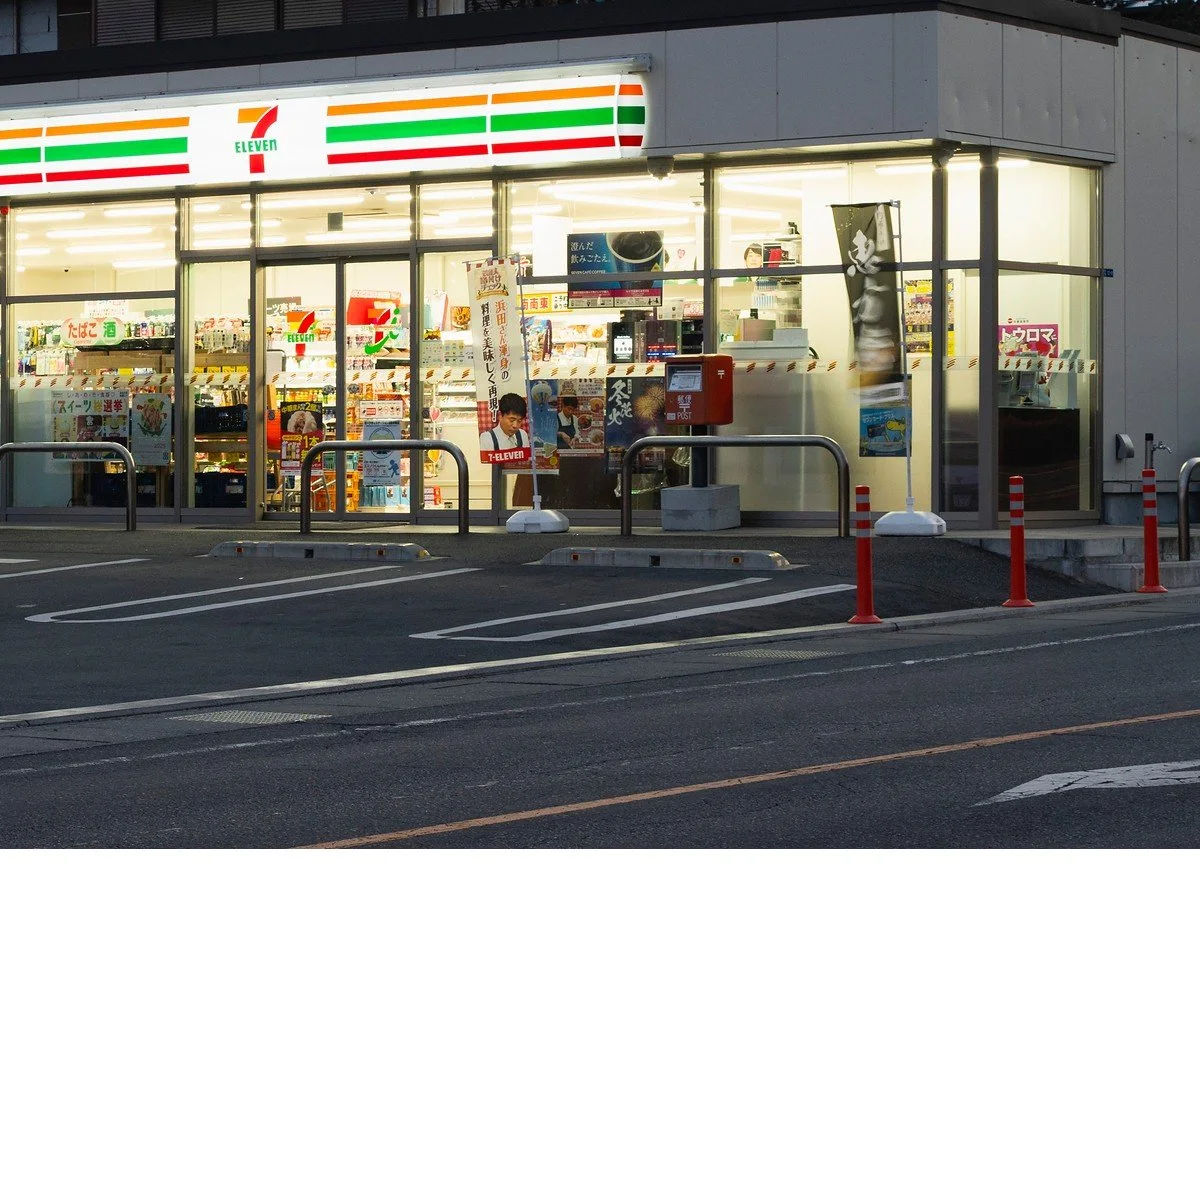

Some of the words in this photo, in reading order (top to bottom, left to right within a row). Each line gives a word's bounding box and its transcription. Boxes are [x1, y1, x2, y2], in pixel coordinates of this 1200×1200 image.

[68, 322, 97, 339] たばこ
[103, 321, 116, 338] 酒
[677, 412, 692, 420] POST
